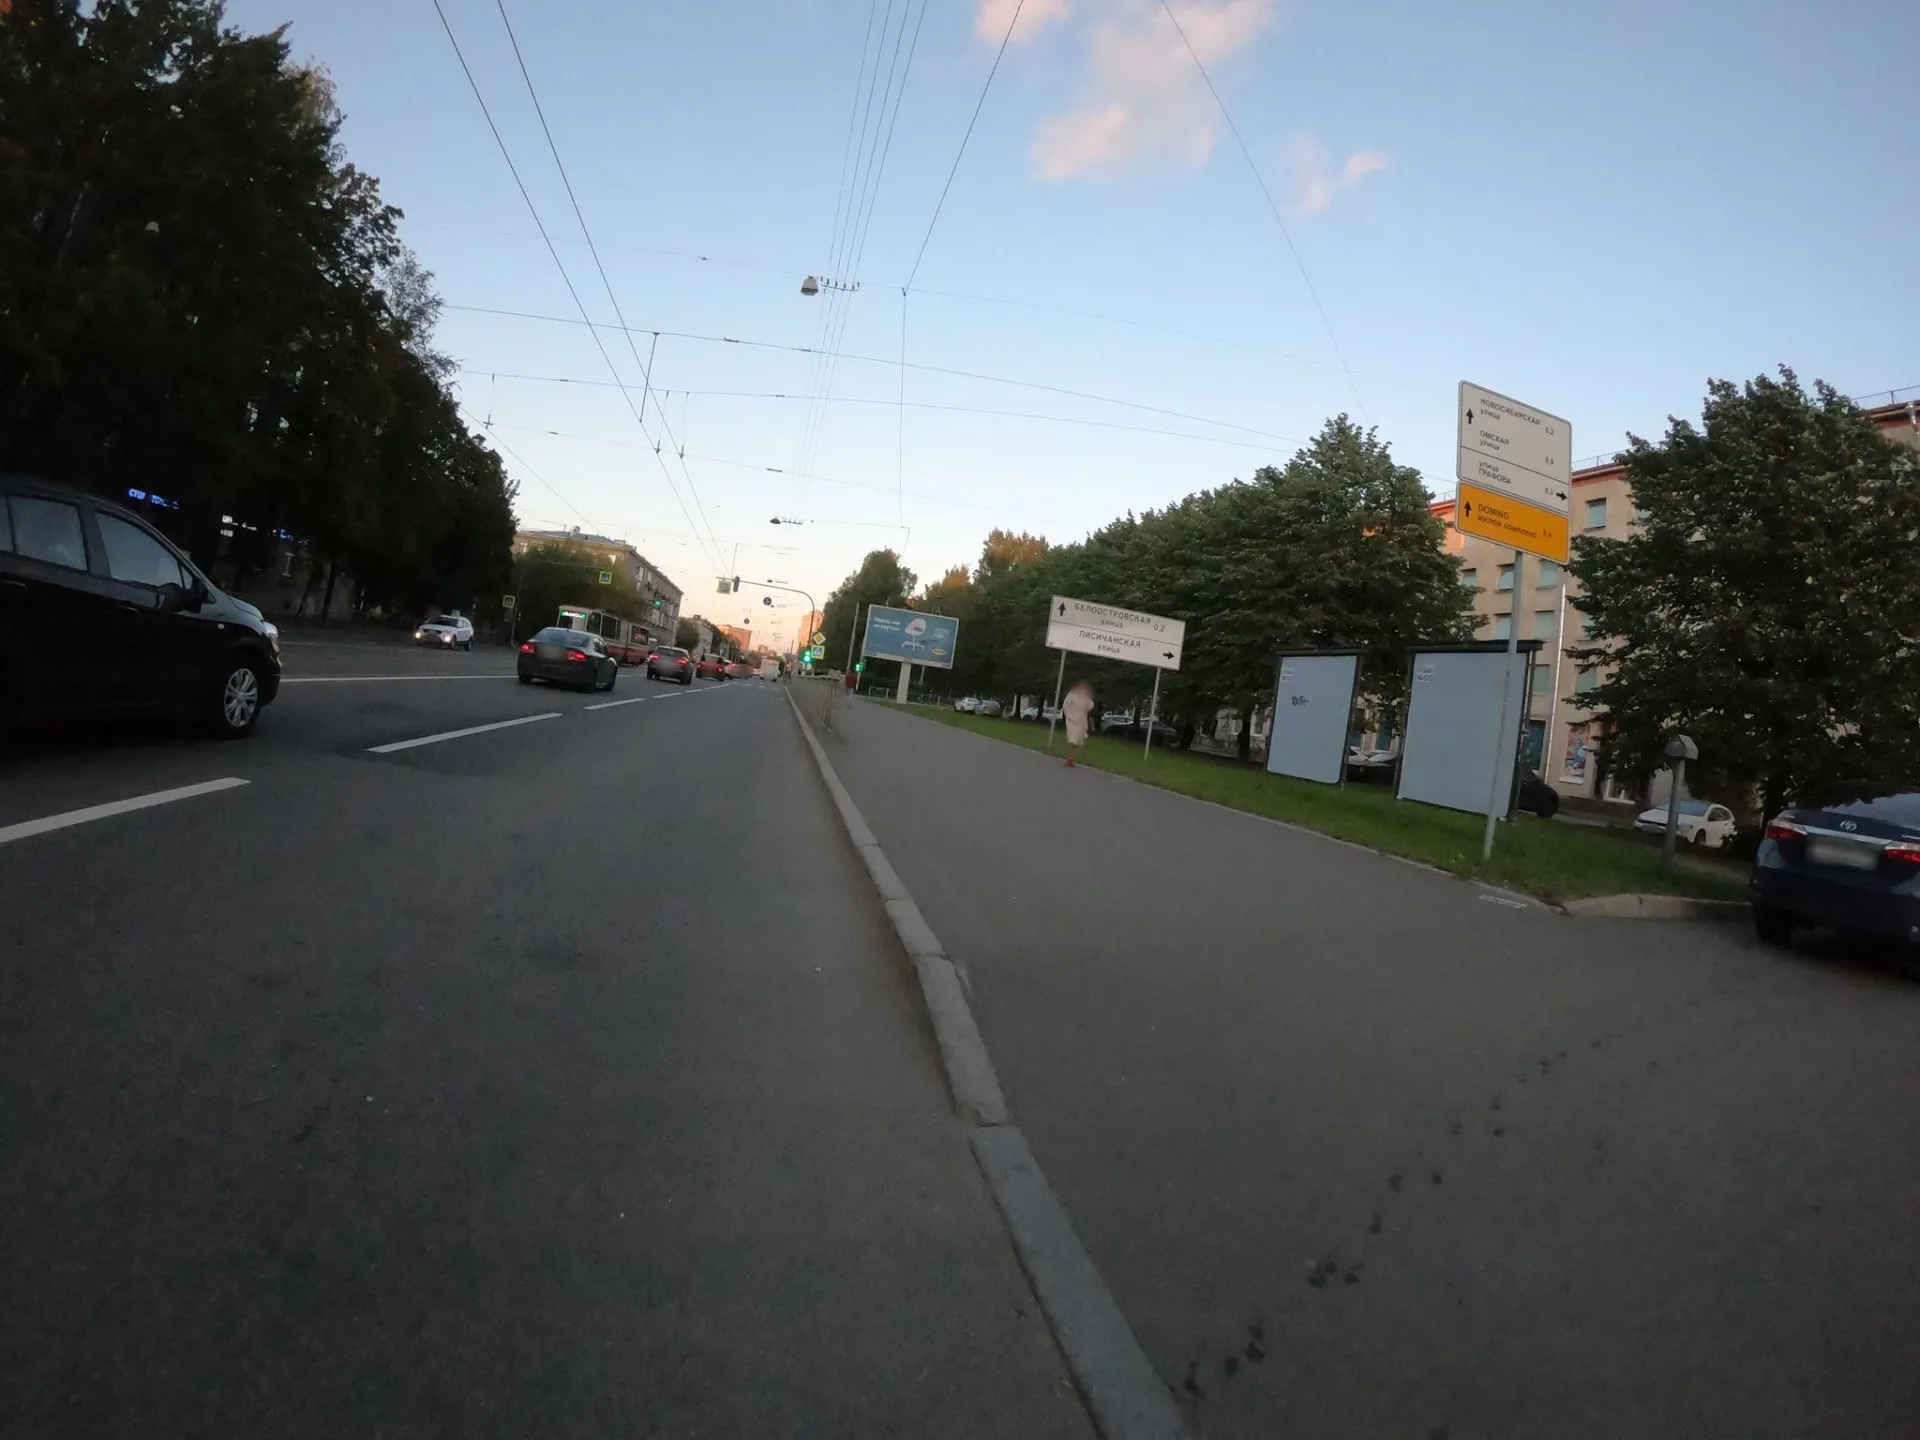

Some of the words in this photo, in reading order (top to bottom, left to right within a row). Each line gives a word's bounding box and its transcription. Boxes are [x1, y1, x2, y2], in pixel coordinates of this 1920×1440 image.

[1480, 398, 1541, 425] НОВОСИБИРСКАЯ
[1480, 408, 1501, 420] улица
[1480, 429, 1510, 446] ОМСКАЯ
[1480, 439, 1500, 451] улица
[1479, 460, 1500, 472] улица
[1478, 468, 1512, 485] ГРАФОВА
[1477, 503, 1510, 520] DOMINO
[1074, 603, 1151, 625] БЕЛООСТРОВСКАЯ
[1100, 619, 1124, 629] улица
[1078, 630, 1141, 648] ЛИСИЧАНСКАЯ
[1097, 644, 1121, 654] улица
